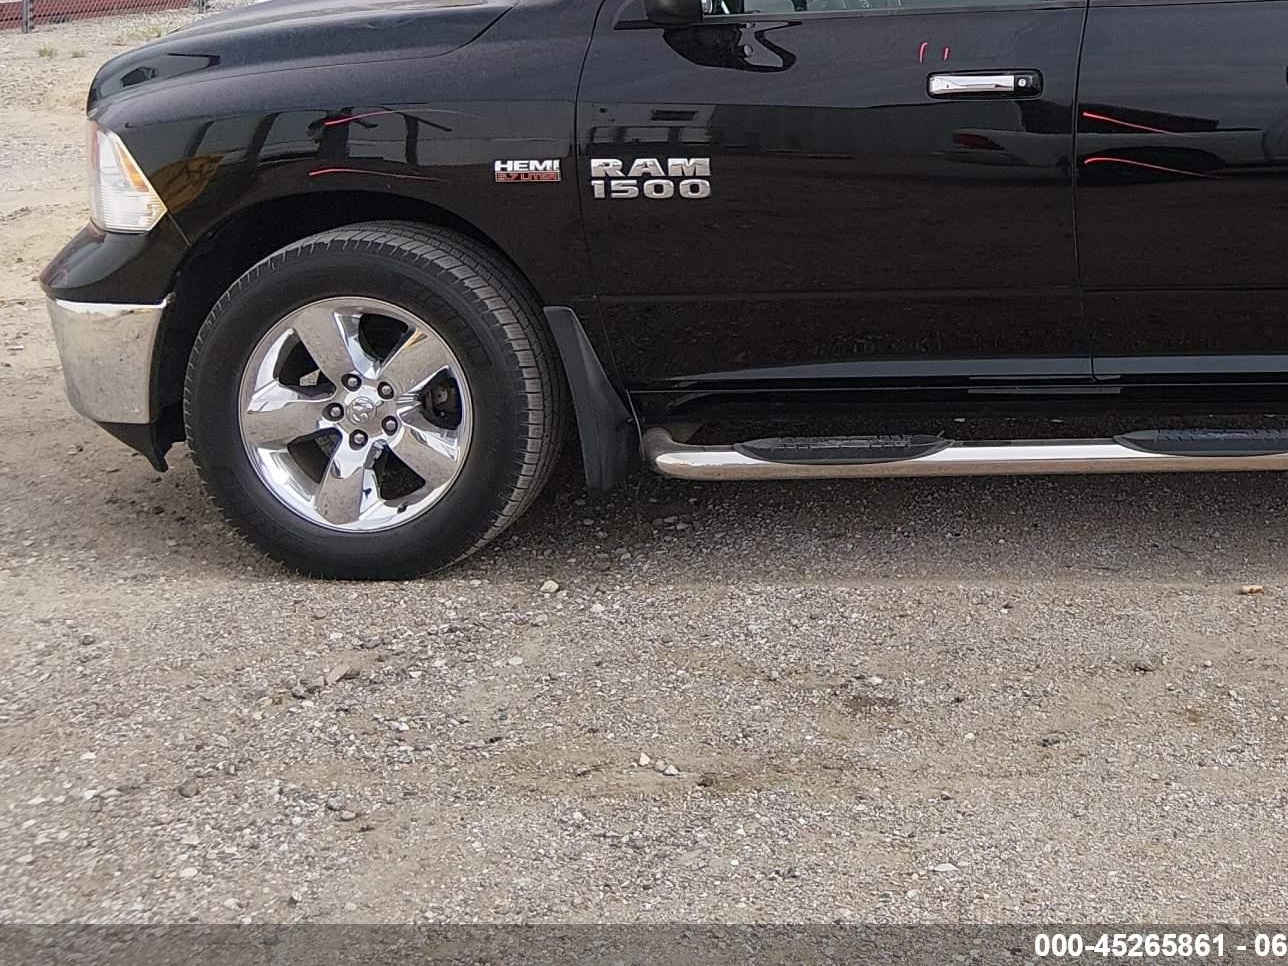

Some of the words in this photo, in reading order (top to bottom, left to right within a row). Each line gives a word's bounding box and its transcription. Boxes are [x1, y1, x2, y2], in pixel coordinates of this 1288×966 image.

[494, 160, 560, 172] HEMI
[590, 157, 711, 177] RAM
[591, 179, 711, 199] 1500
